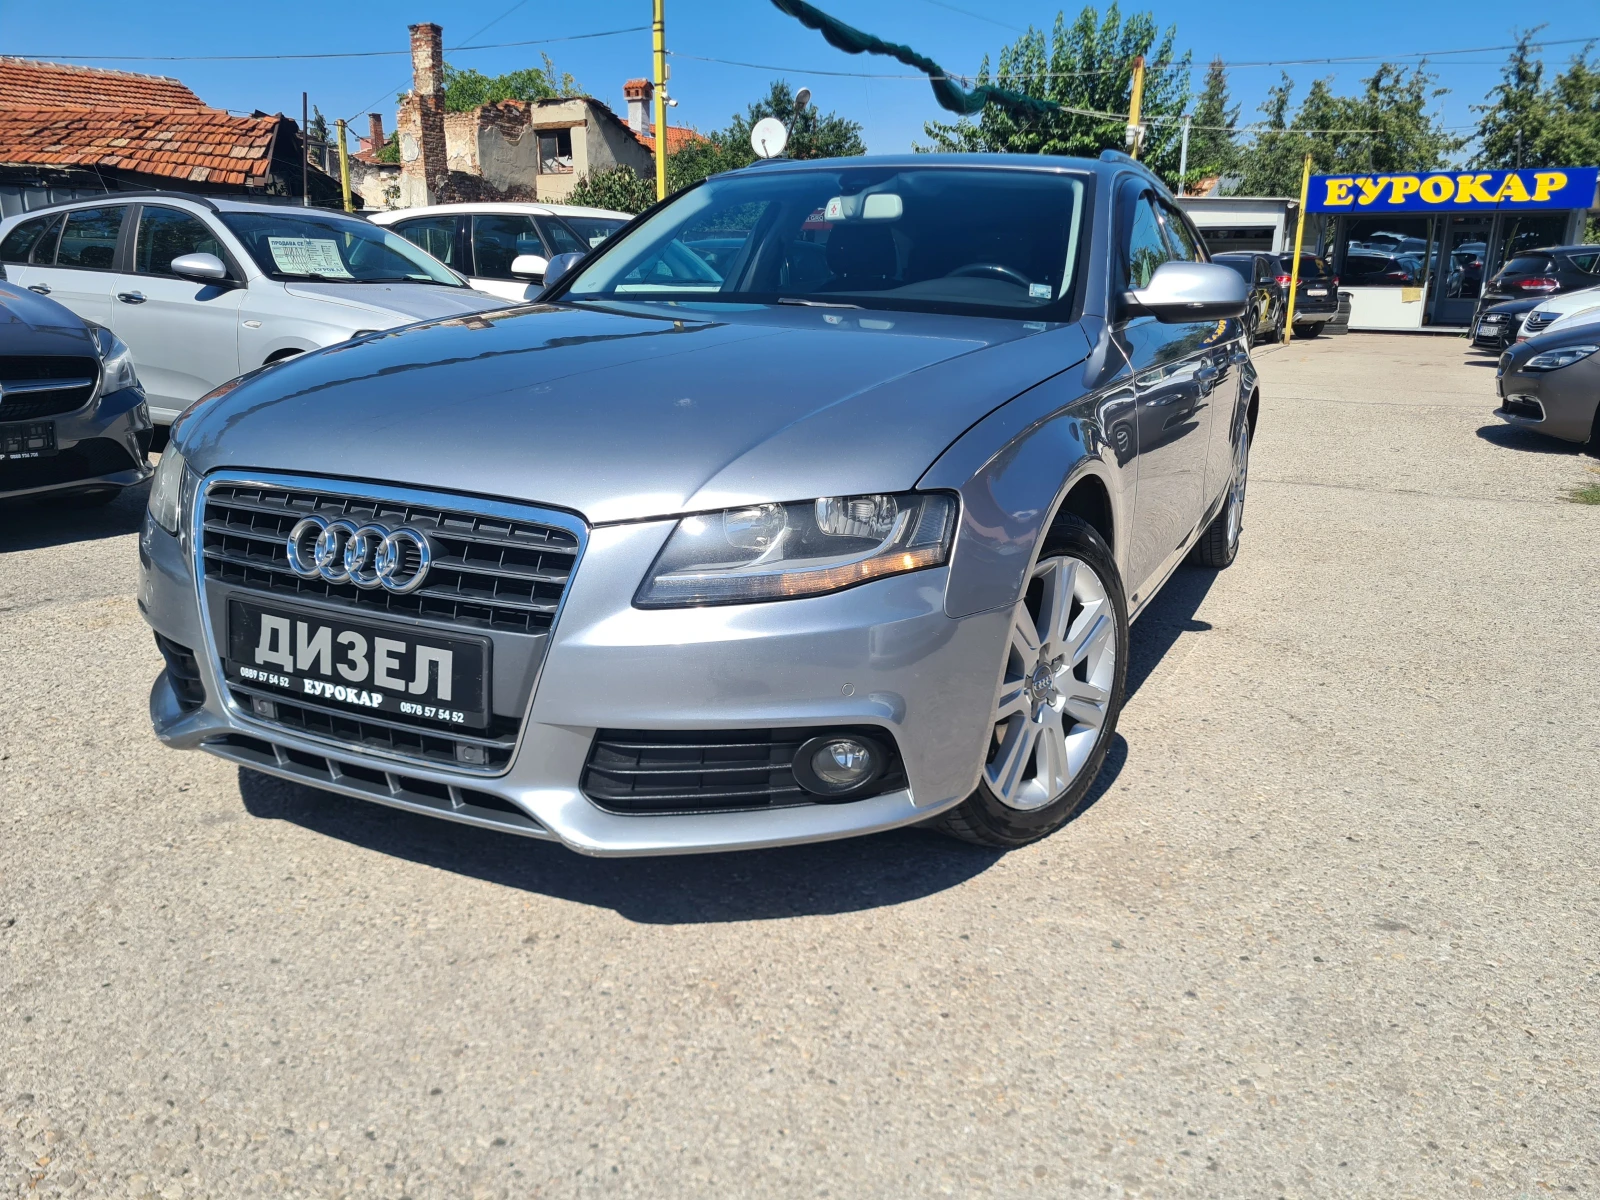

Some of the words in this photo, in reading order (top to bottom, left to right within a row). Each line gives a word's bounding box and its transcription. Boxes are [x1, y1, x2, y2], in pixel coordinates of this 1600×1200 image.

[1323, 172, 1568, 206] ЕУРОКАР
[255, 613, 453, 701] ДИЗЕЛ
[240, 667, 258, 679] 0889
[259, 671, 268, 682] 57
[269, 674, 279, 685] 54
[280, 676, 290, 688] 52
[303, 678, 383, 708] ЕУРОКАР
[400, 701, 423, 716] 0878
[424, 706, 437, 718] 57
[438, 709, 451, 721] 54
[452, 711, 465, 723] 52
